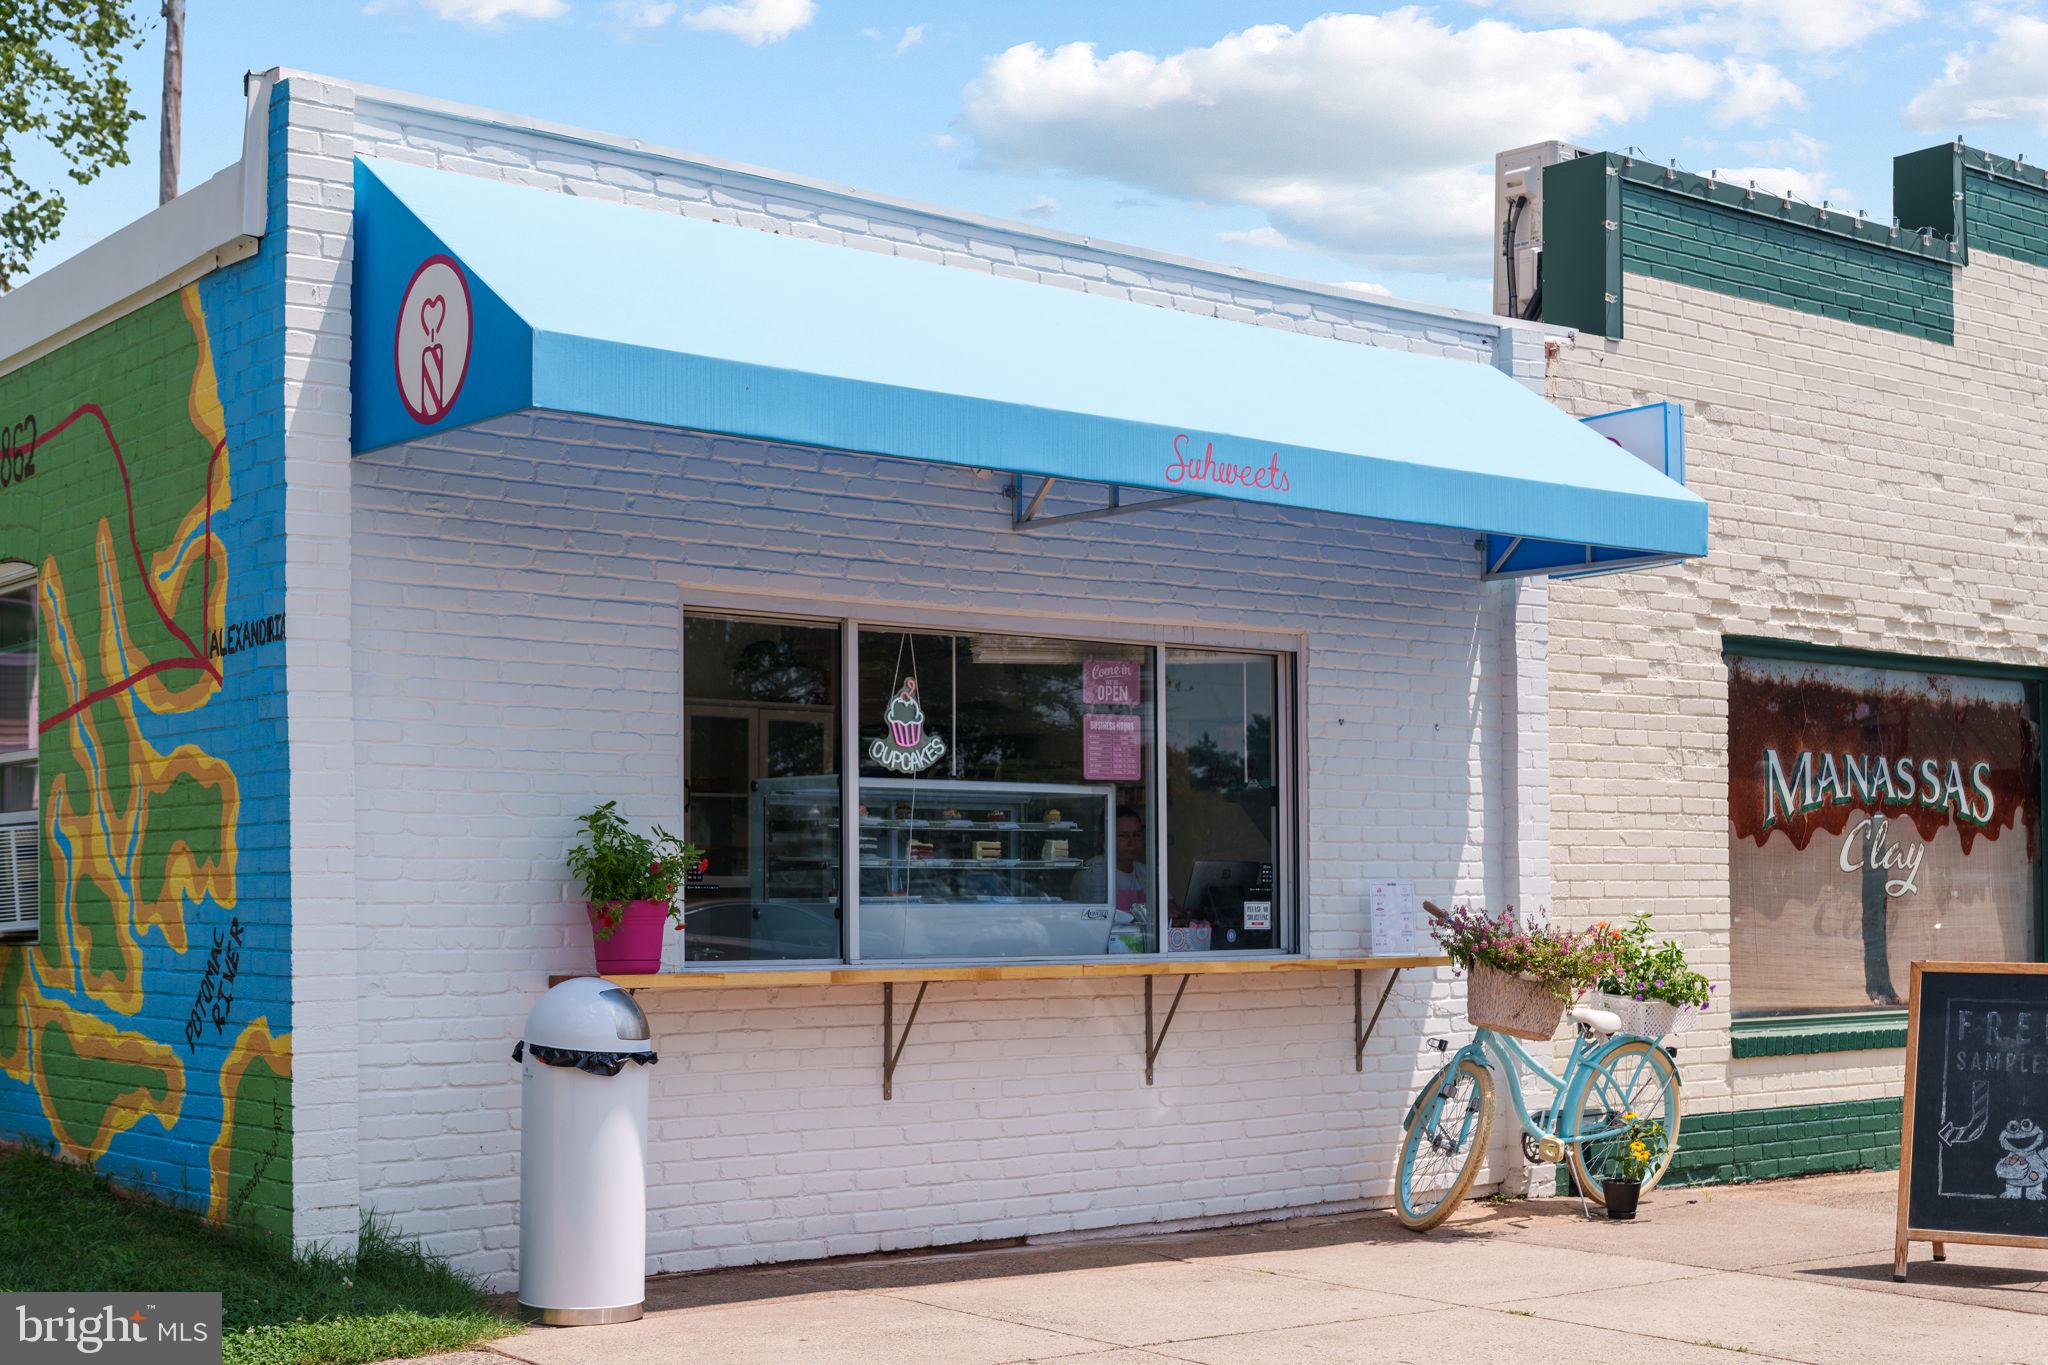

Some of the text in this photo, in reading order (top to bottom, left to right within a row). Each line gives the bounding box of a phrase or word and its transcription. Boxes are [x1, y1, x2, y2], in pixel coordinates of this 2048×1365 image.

[1165, 434, 1290, 492] Suhweets
[210, 612, 287, 659] ALEXANDRIA
[1092, 664, 1131, 679] Come in
[1097, 685, 1128, 701] OPEN
[872, 738, 945, 770] CUPCAKES
[1763, 748, 1994, 828] MANASSAS
[1839, 819, 1925, 897] Clay
[185, 927, 225, 1054] POTOMAC
[212, 917, 244, 1036] RIVER
[1959, 1010, 2048, 1045] FRE
[1957, 1050, 2048, 1074] SAMPLE
